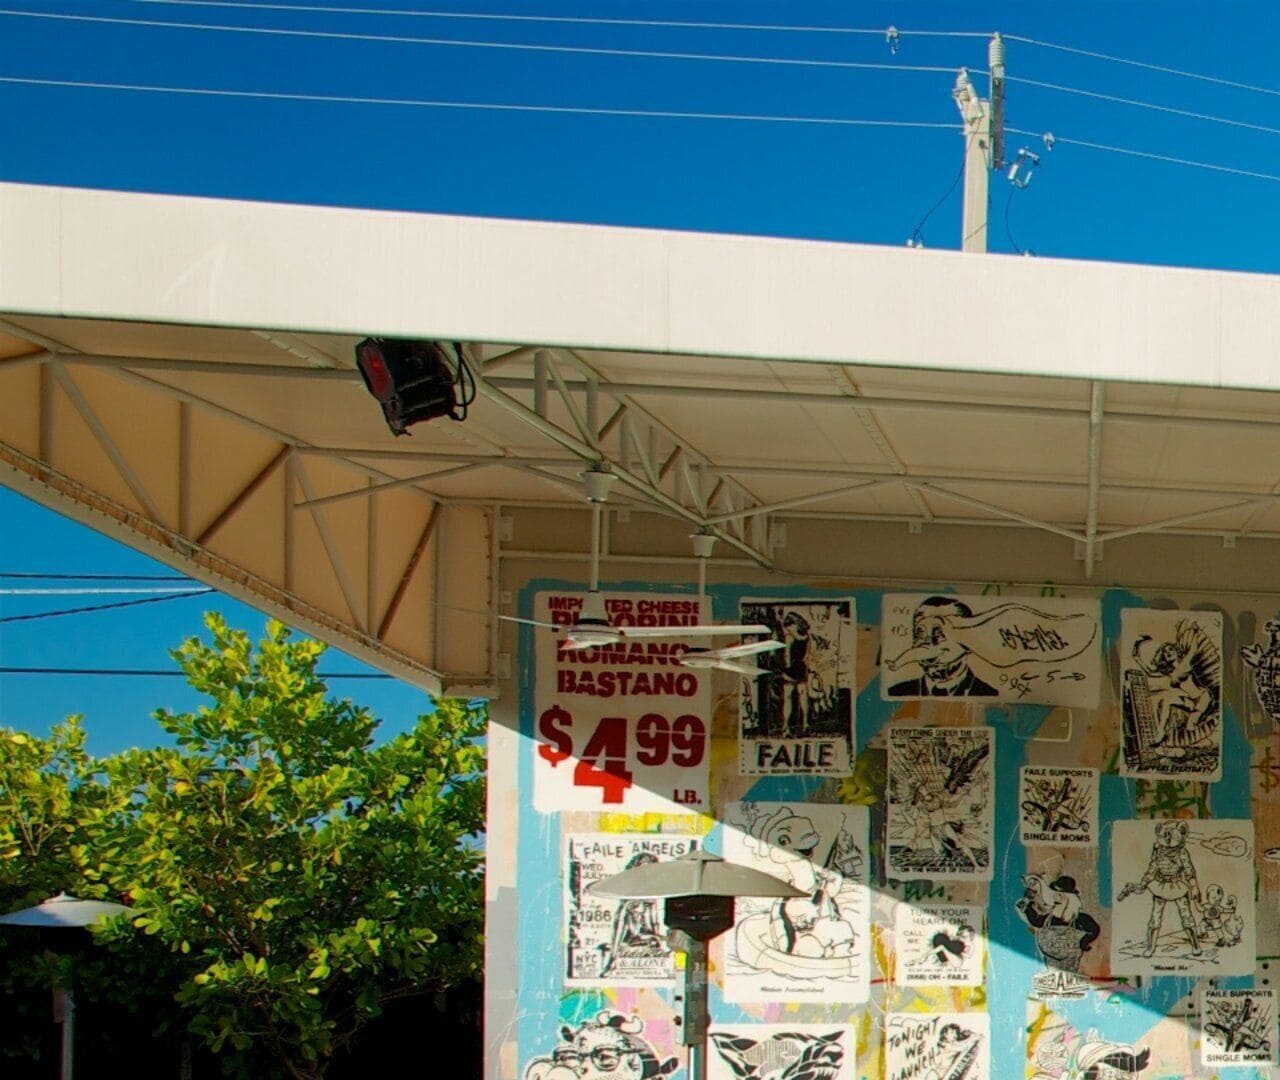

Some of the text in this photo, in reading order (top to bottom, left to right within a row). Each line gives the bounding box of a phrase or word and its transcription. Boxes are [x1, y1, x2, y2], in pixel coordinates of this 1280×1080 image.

[637, 601, 699, 614] CHEESE
[558, 670, 698, 697] BASTANO
[757, 743, 835, 768] FAILE
[1024, 769, 1093, 778] FAILE SUPPORTS
[674, 789, 701, 804] LB.
[1023, 833, 1091, 842] SINGLE MOMS
[583, 842, 624, 859] FAILE
[579, 910, 612, 922] 1986
[910, 908, 970, 917] TURN YOUR
[913, 917, 946, 925] HEART
[575, 953, 598, 964] NYC
[1205, 990, 1273, 998] FAILE SUPPORTS
[888, 1016, 941, 1051] TONIGHT
[905, 1041, 926, 1058] WE
[1206, 1053, 1272, 1062] SINGLE MOMS
